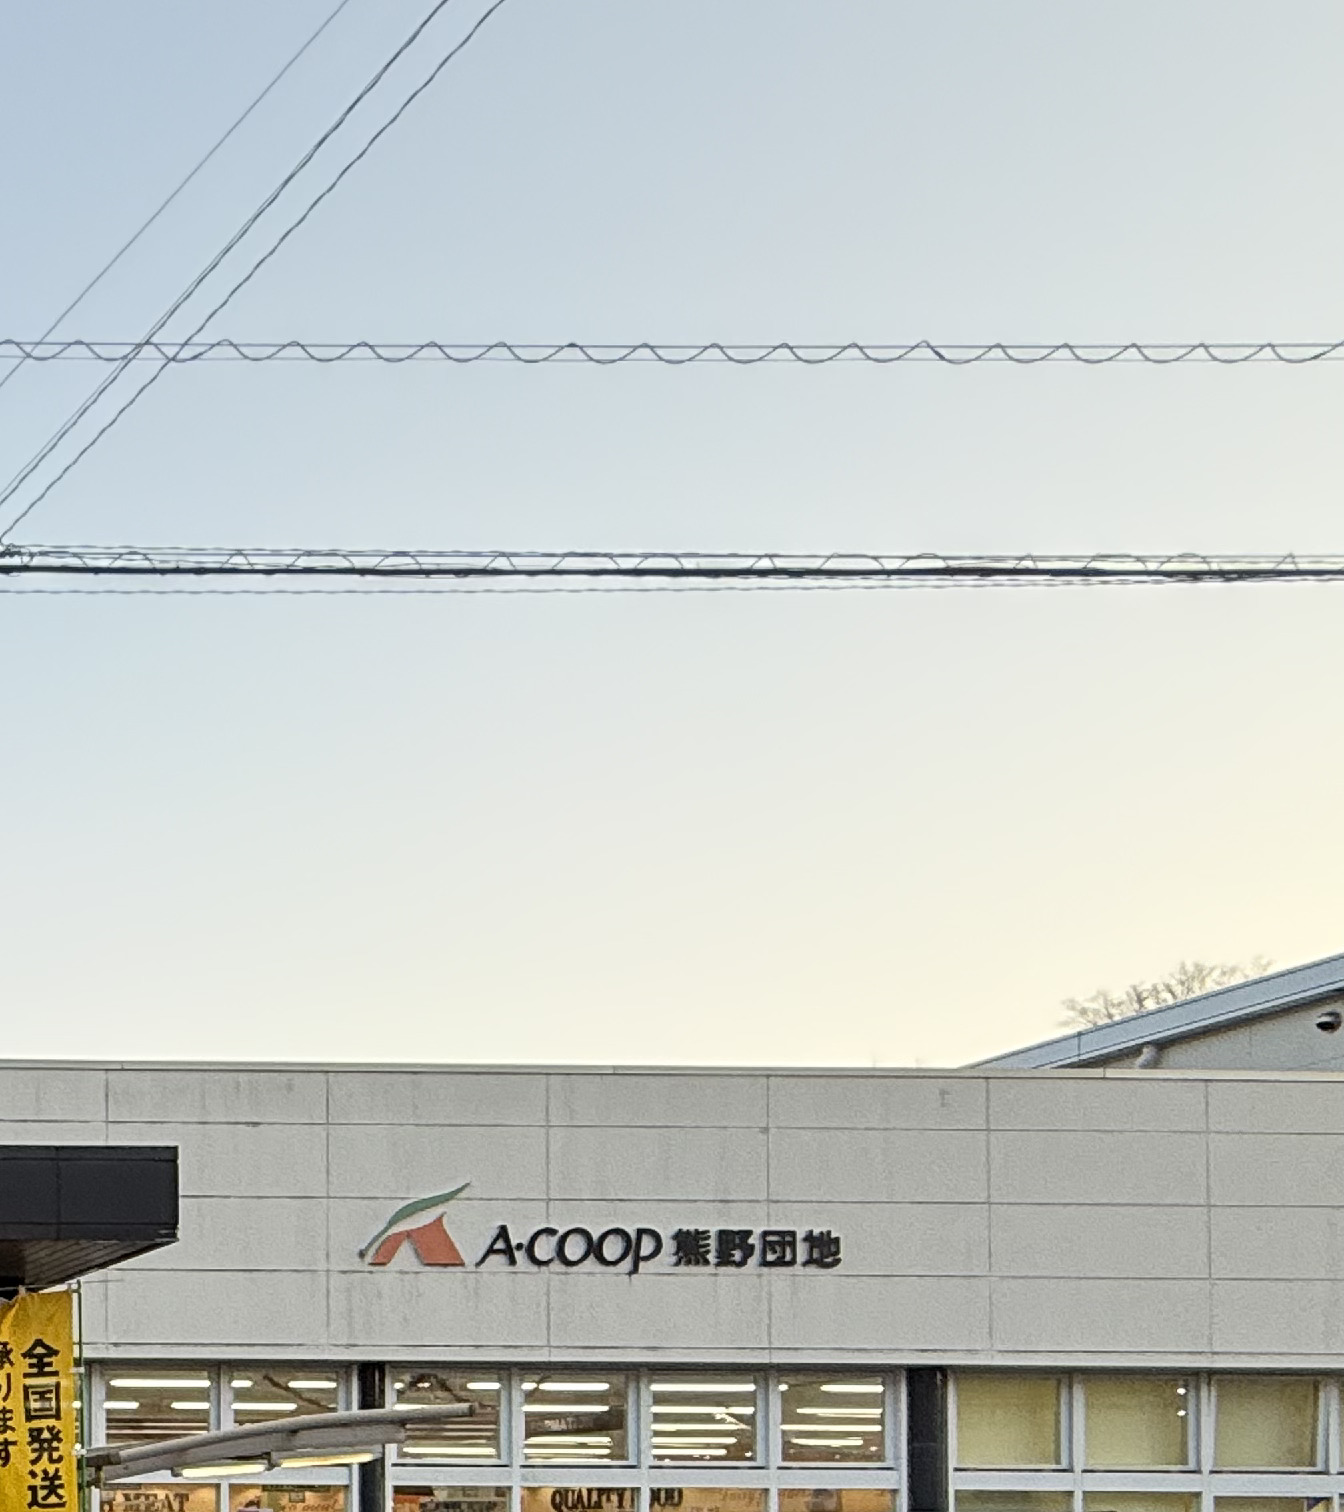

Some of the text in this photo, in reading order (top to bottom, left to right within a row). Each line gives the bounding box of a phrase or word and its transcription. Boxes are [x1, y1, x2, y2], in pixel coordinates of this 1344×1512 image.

[669, 1227, 843, 1270] 熊野団地
[20, 1338, 68, 1510] 全国発送
